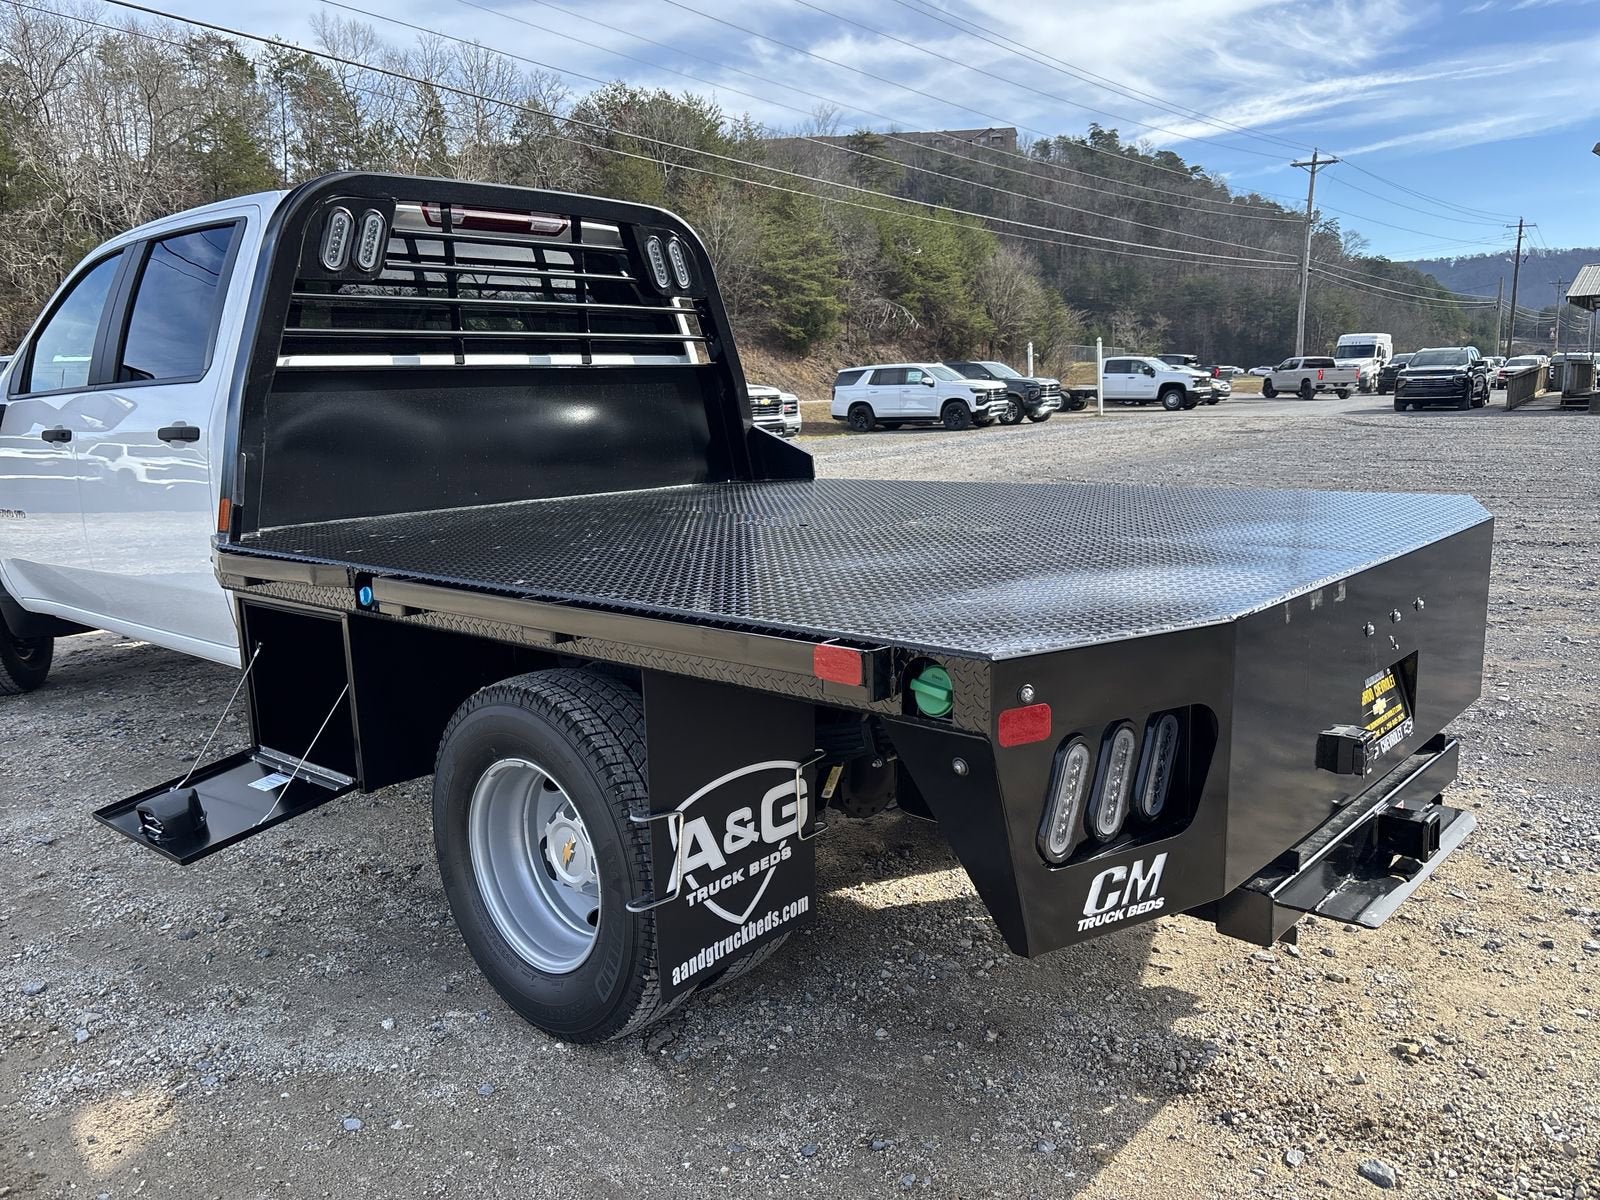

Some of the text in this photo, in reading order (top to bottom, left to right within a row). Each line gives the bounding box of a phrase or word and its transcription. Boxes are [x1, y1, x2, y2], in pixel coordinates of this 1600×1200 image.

[666, 778, 808, 893] A&G
[686, 867, 745, 907] TRUCK
[1077, 897, 1165, 932] TRUCK BEDS
[1083, 852, 1168, 916] CM
[672, 895, 809, 986] aandgtruckbeds.com
